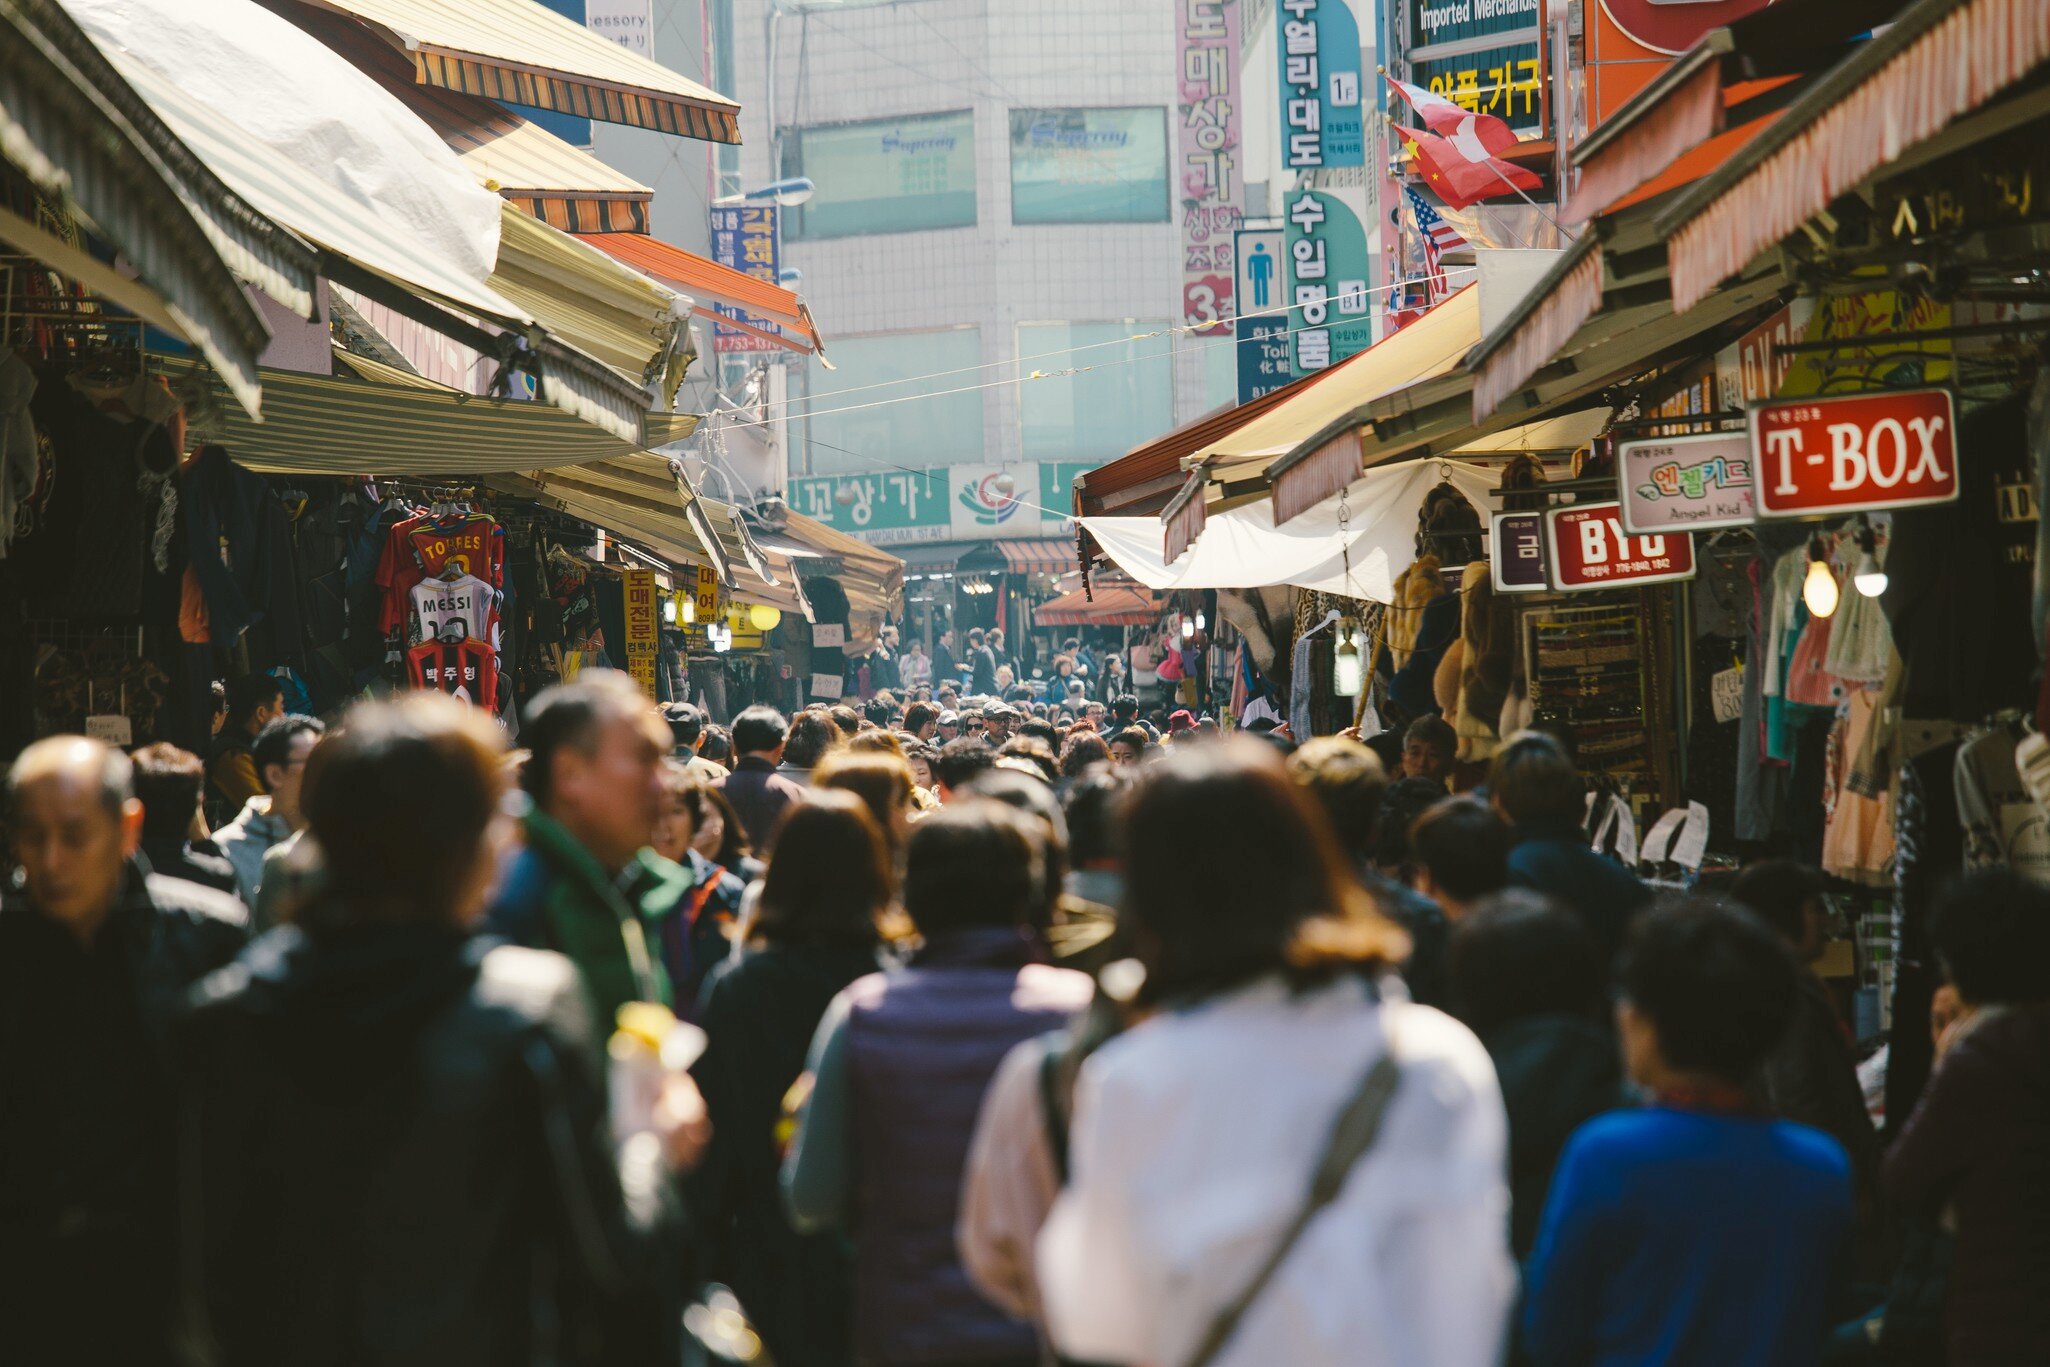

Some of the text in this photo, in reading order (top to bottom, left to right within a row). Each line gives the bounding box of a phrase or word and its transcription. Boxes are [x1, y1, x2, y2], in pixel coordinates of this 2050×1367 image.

[1420, 0, 1470, 35] Imported
[1333, 78, 1353, 100] 1F
[1291, 194, 1330, 369] 수입명품
[1766, 415, 1950, 496] T-BOX
[1651, 457, 1752, 498] 엔젤키드
[1670, 502, 1741, 519] Angel Kid
[423, 596, 472, 613] MESSI
[629, 571, 652, 640] 도매전문
[426, 667, 476, 682] 박주영
